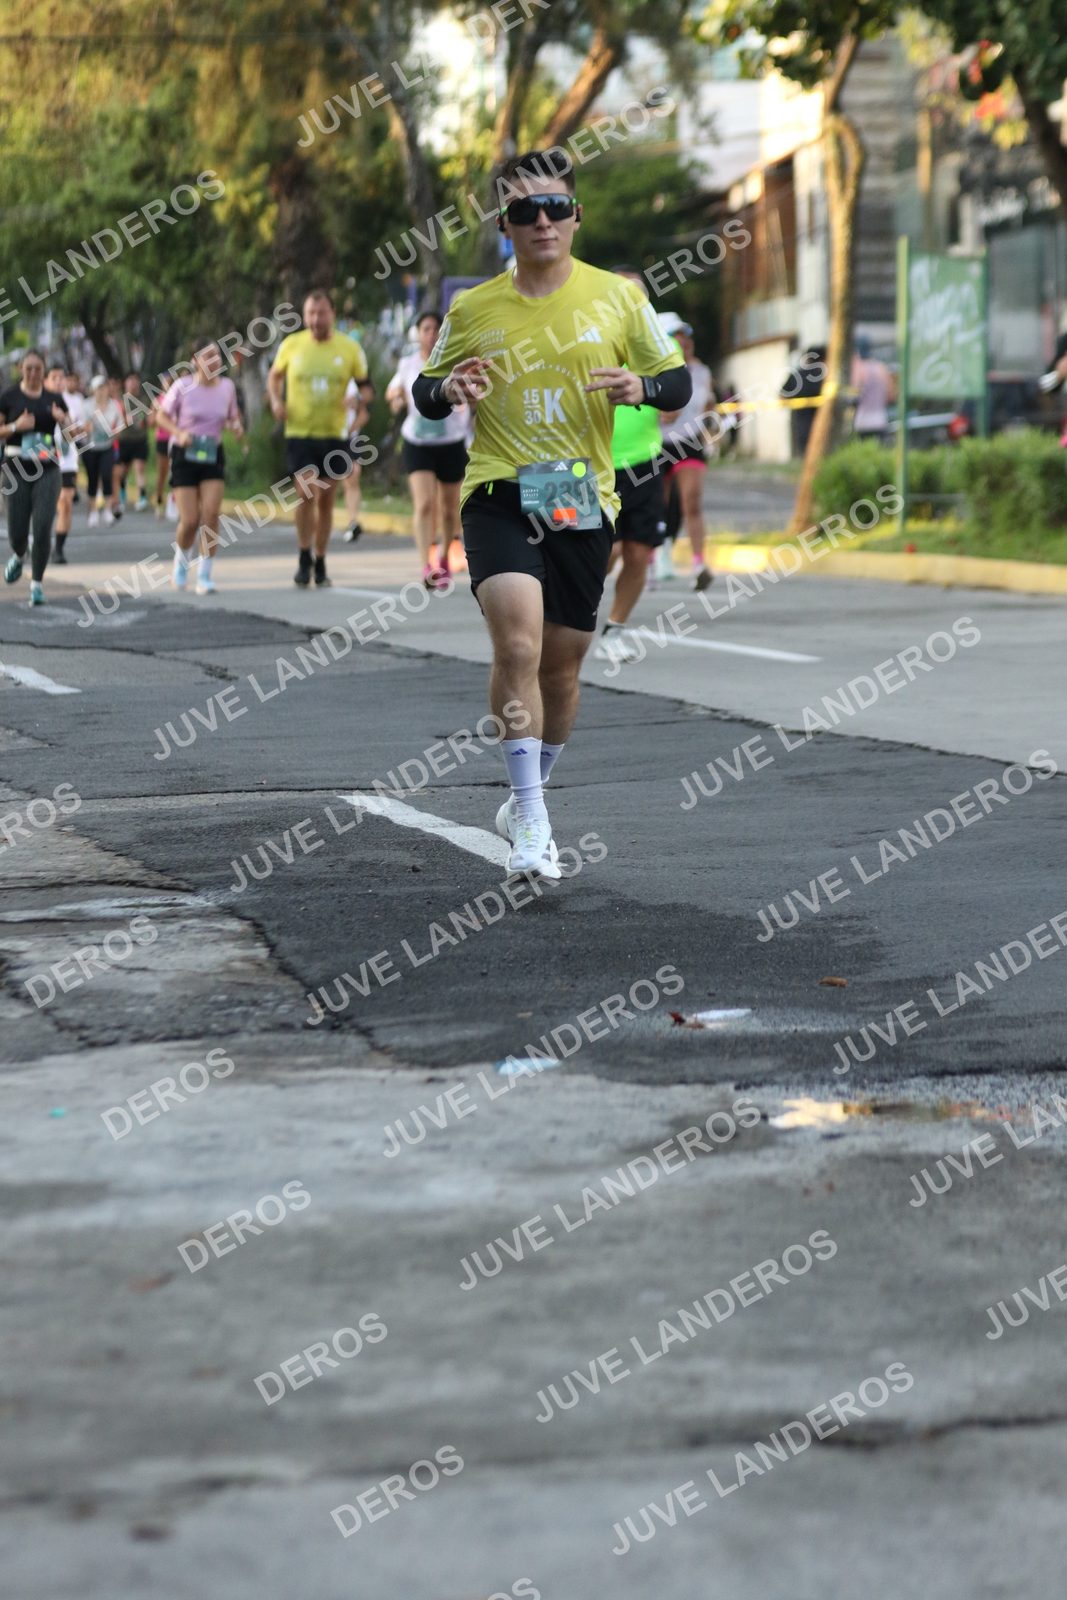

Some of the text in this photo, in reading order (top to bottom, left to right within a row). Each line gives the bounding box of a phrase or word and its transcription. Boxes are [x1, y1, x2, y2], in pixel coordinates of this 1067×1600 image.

[523, 388, 540, 404] 15
[543, 388, 567, 424] K
[524, 409, 542, 425] 30
